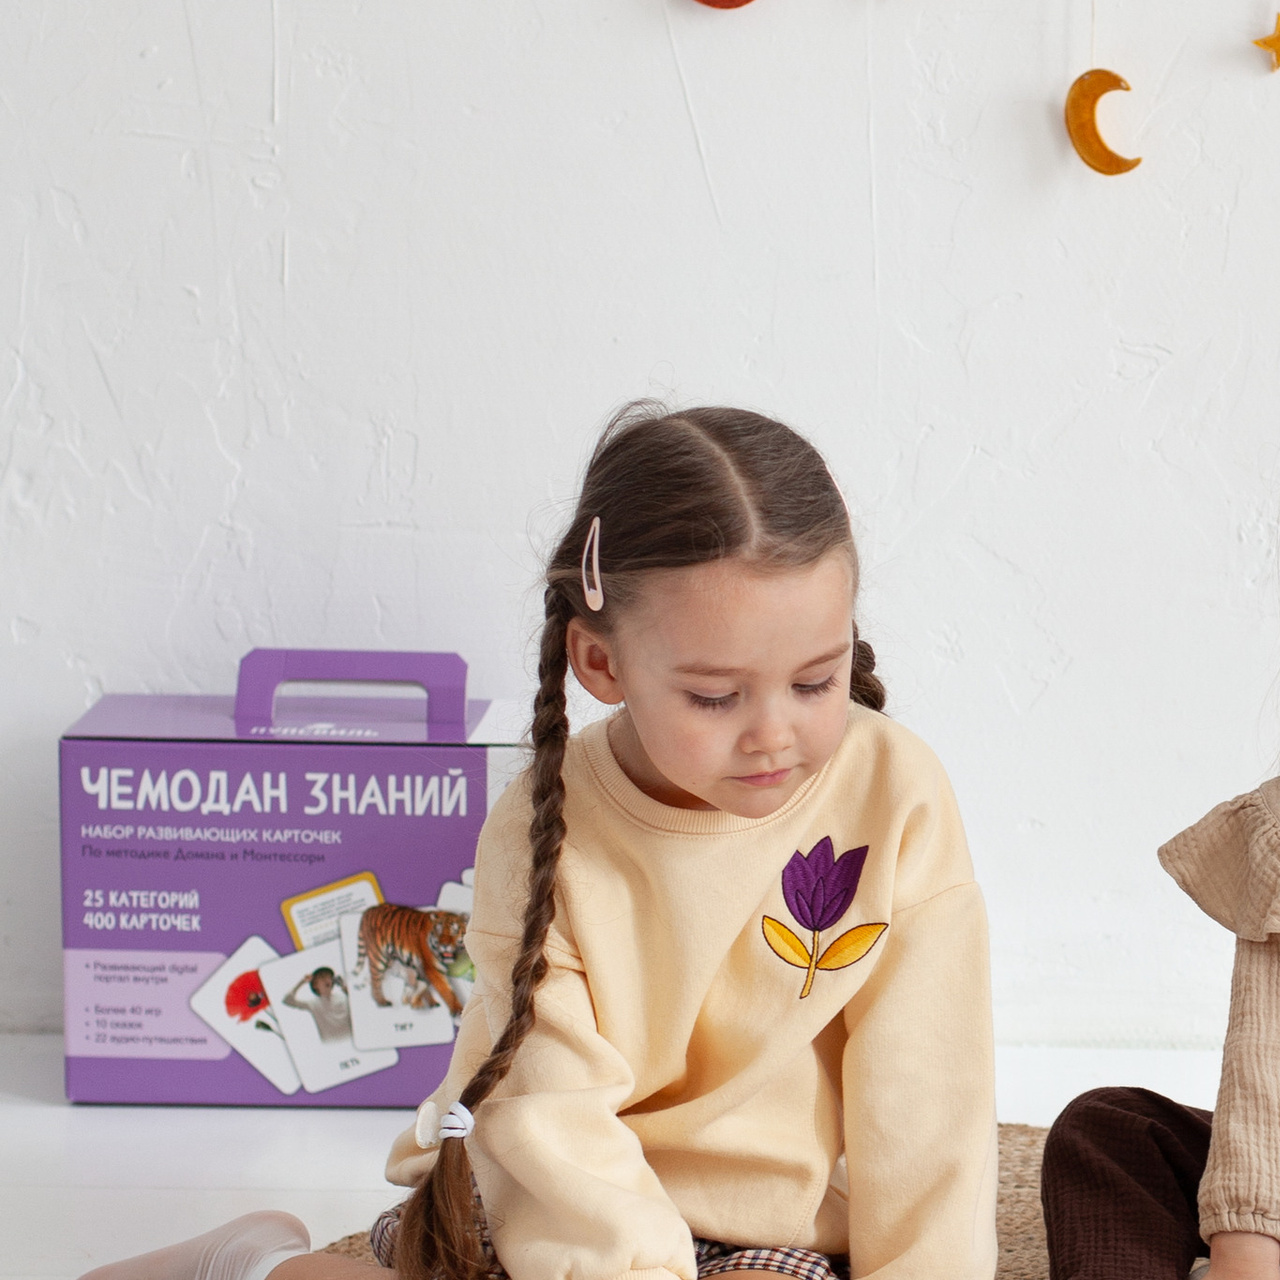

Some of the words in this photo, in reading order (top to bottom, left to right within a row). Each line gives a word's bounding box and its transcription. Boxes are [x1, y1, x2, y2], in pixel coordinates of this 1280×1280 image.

[80, 766, 288, 816] ЧЕМОДАН
[303, 768, 468, 817] ЗНАНИЙ
[80, 824, 135, 839] НАБОР
[137, 825, 259, 843] РАЗВИВАЮЩИХ
[262, 828, 343, 844] КАРТОЧЕК
[81, 844, 102, 858] По
[105, 847, 170, 861] методике
[229, 850, 239, 861] и
[242, 849, 326, 864] Монтессори
[82, 889, 104, 908] 25
[108, 889, 200, 909] КАТЕГОРИЙ
[82, 912, 116, 930] 400
[119, 913, 202, 932] КАРТОЧЕК
